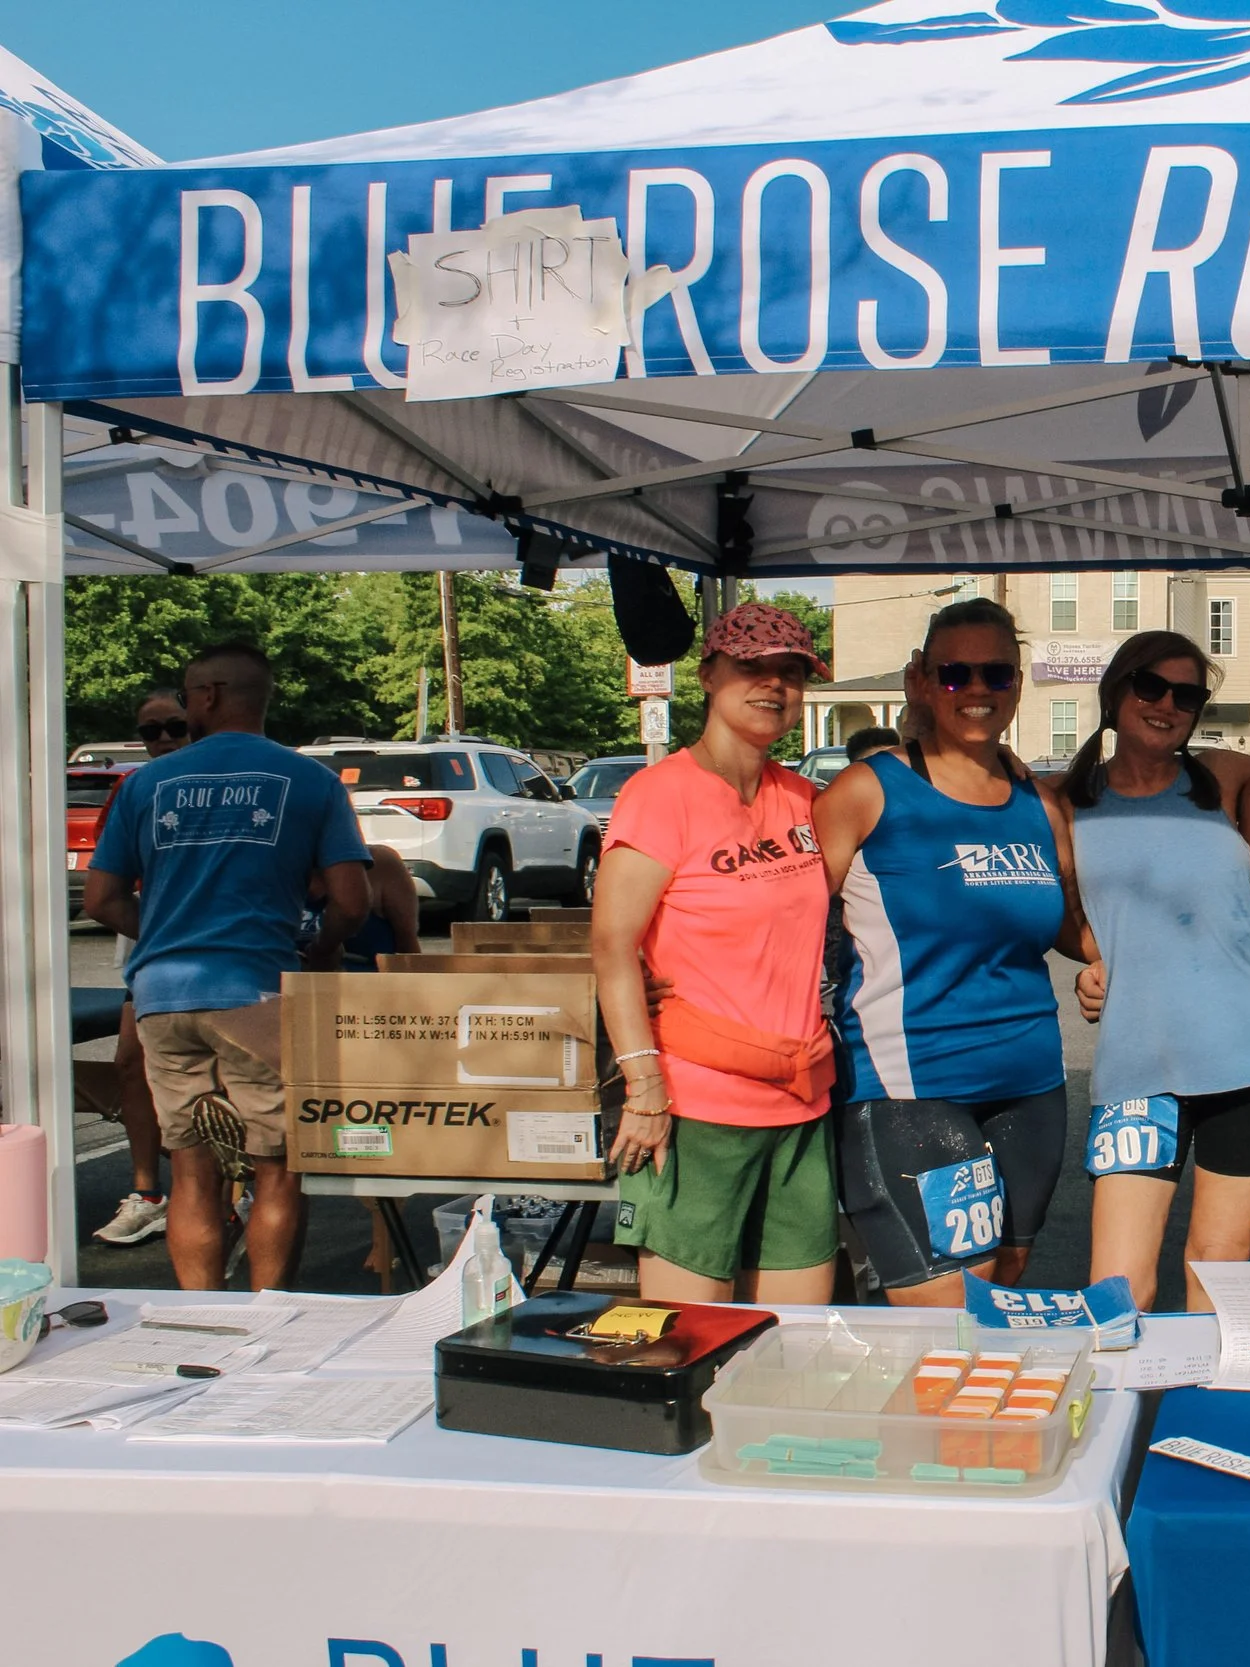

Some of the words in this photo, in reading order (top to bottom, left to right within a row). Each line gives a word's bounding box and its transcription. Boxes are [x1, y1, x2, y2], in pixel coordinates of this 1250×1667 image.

[434, 236, 611, 311] SHIRT
[624, 149, 1052, 377] ROSE
[418, 338, 481, 367] Race
[489, 333, 553, 363] Day
[489, 354, 611, 383] Registration
[1046, 656, 1102, 664] 501.376.6555
[1046, 665, 1070, 675] LIVE
[1073, 666, 1102, 675] HERE
[176, 787, 214, 808] BLUE
[221, 786, 262, 806] ROSE
[710, 838, 788, 874] GAME
[990, 843, 1052, 873] ARK
[964, 870, 1008, 878] ARKANSAS
[335, 1014, 360, 1026] DIM:
[363, 1014, 386, 1026] L:55
[389, 1014, 407, 1026] CM
[410, 1015, 418, 1026] X
[420, 1015, 434, 1026] W:
[438, 1015, 450, 1027] 37
[474, 1015, 482, 1027] X
[485, 1015, 498, 1027] H:
[501, 1016, 514, 1027] 15
[516, 1016, 534, 1027] CM
[335, 1030, 360, 1041] DIM:
[363, 1030, 402, 1041] L:21.65
[404, 1030, 416, 1041] IN
[418, 1030, 428, 1041] X
[475, 1030, 487, 1041] IN
[490, 1030, 498, 1041] X
[501, 1030, 536, 1042] H:5.91
[538, 1030, 550, 1042] IN
[298, 1098, 497, 1127] SPORT-TEK
[1125, 1098, 1146, 1111] GTS
[1094, 1126, 1158, 1170] 307
[975, 1164, 992, 1184] GTS
[946, 1195, 1004, 1254] 288
[990, 1289, 1084, 1312] 413
[1012, 1318, 1042, 1326] GTS
[1160, 1440, 1204, 1458] BLUE
[1202, 1452, 1248, 1473] ROSE
